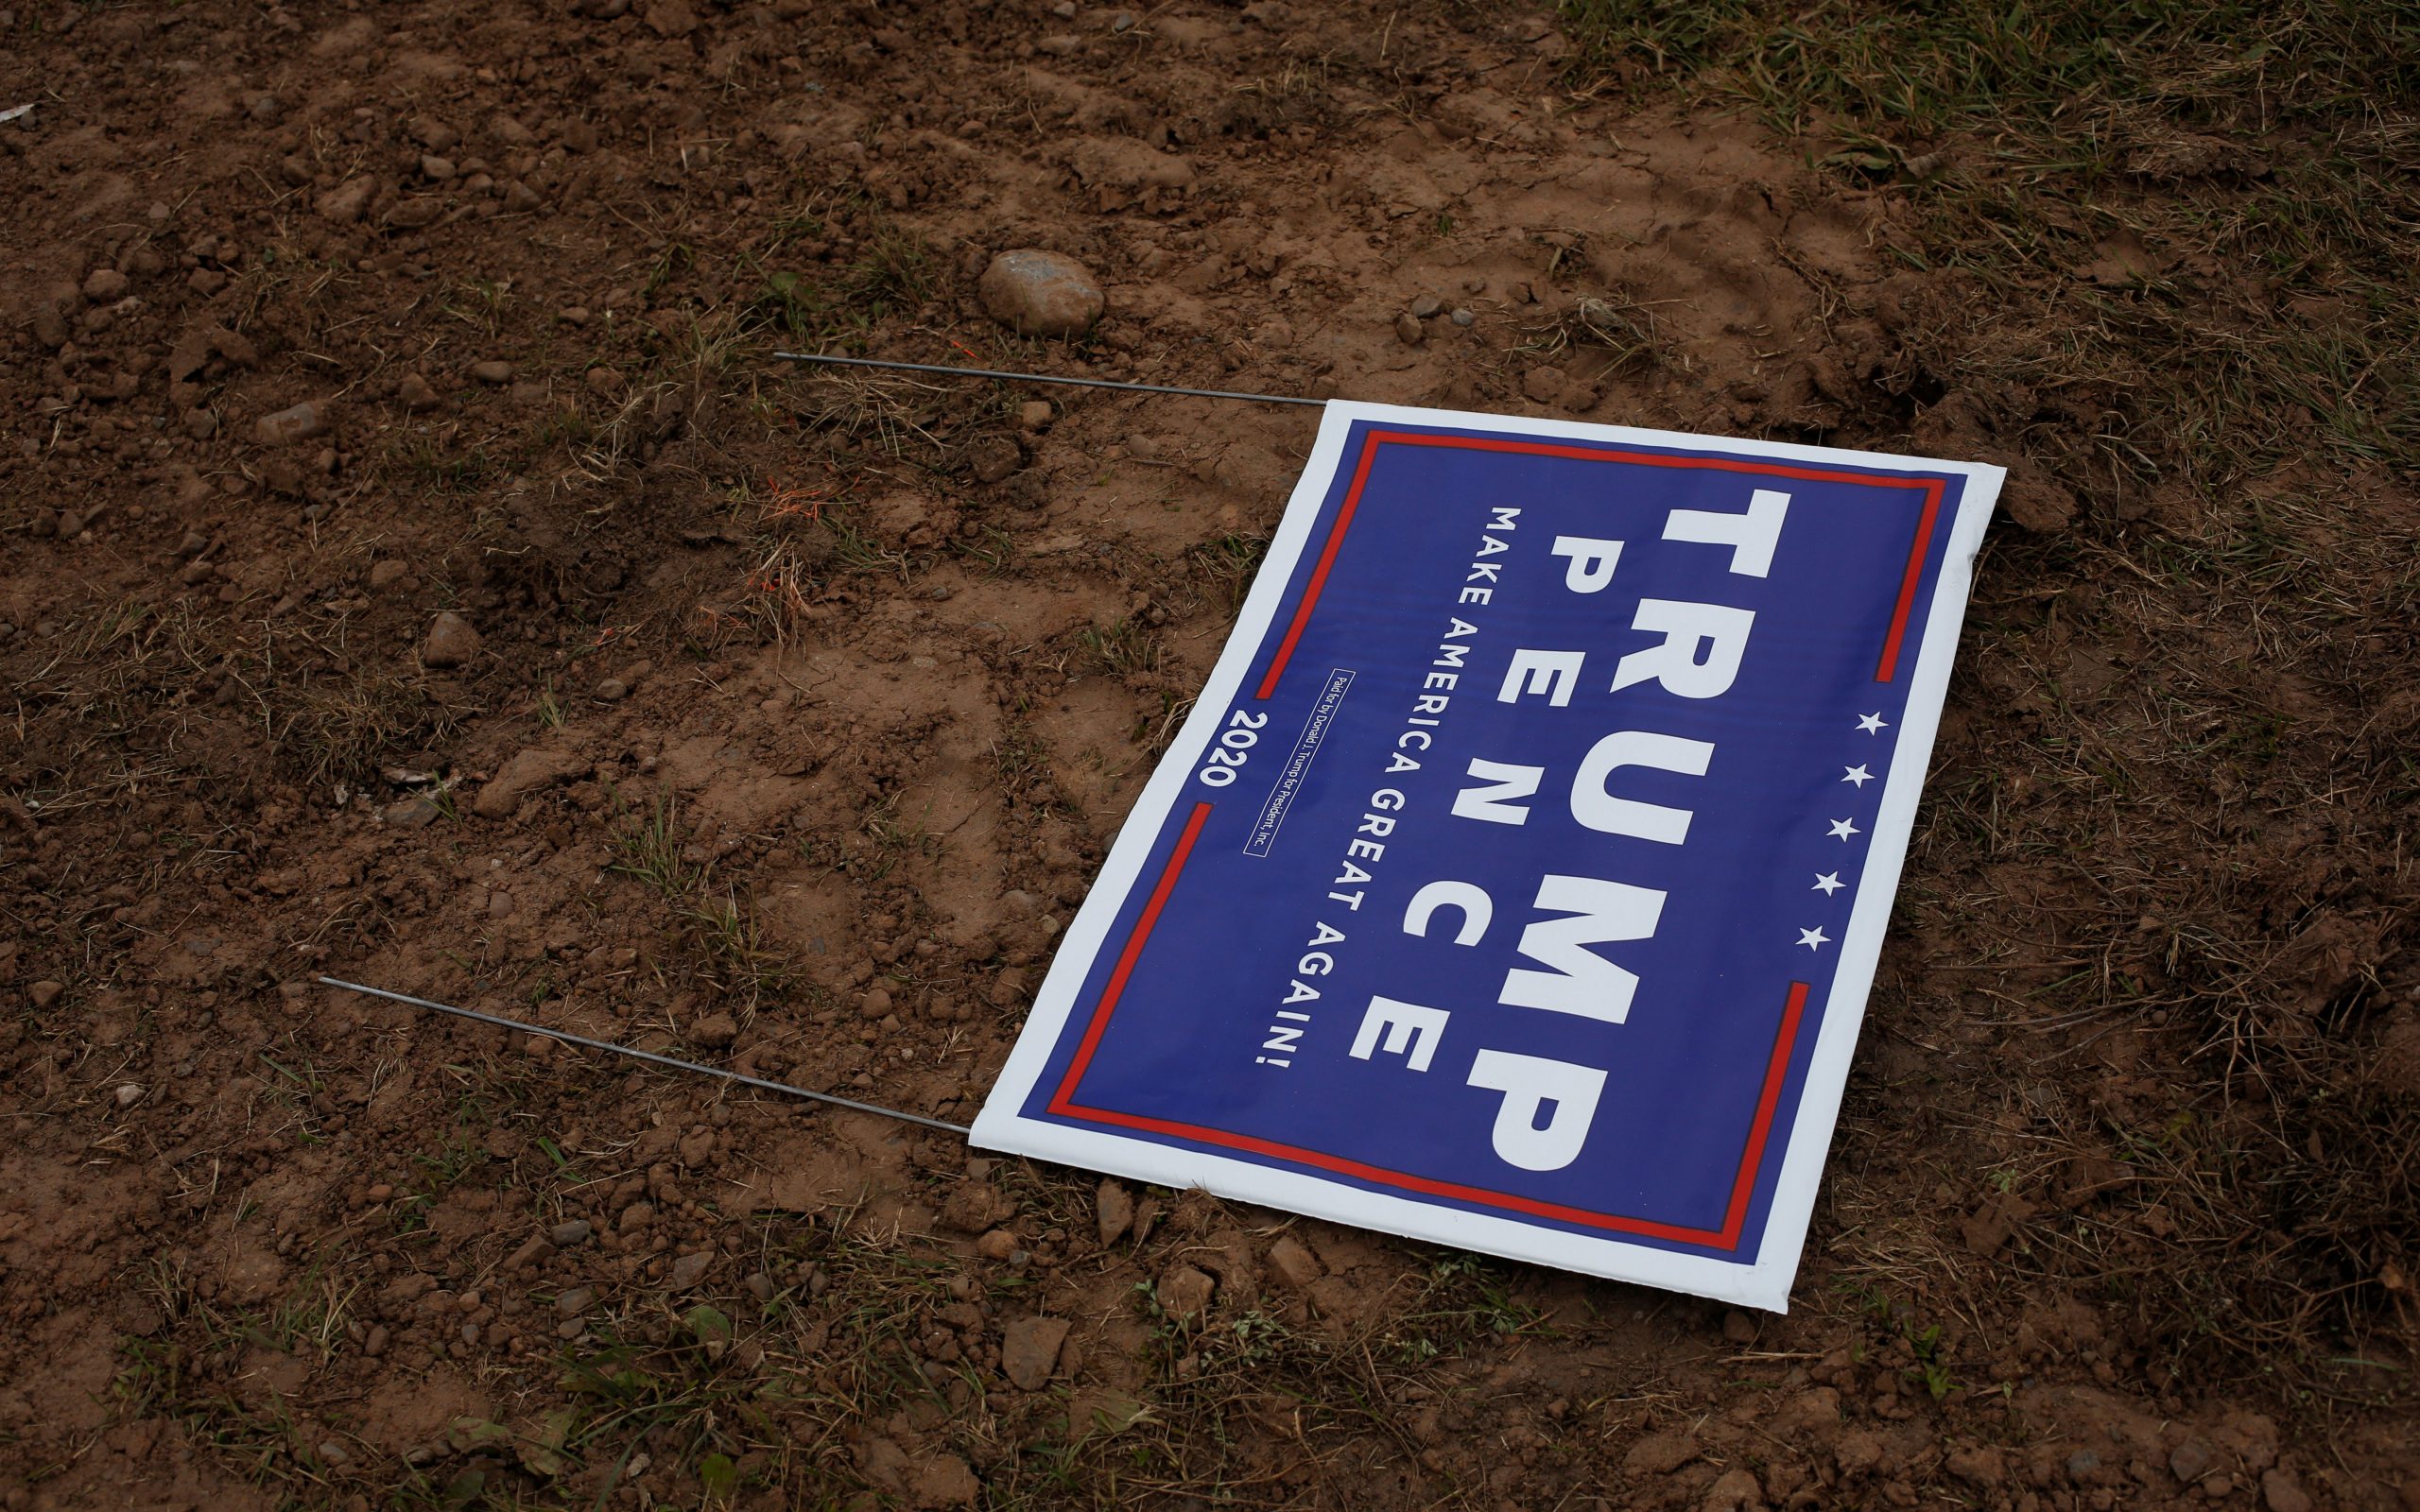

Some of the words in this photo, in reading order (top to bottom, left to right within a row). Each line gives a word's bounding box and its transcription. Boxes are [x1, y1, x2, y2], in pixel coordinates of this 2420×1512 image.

[1458, 507, 1522, 606] MAKE
[1324, 693, 1340, 704] for
[1330, 677, 1348, 693] Paid
[1384, 616, 1478, 773] AMERICA
[1305, 715, 1328, 744] Donald
[1317, 704, 1334, 714] by
[1199, 710, 1269, 787] 2020
[1288, 751, 1310, 778] Trump
[1283, 779, 1298, 790] for
[1348, 535, 1625, 1073] PENCE
[1259, 790, 1291, 831] President,
[1465, 489, 1792, 1172] TRUMP
[1253, 833, 1270, 847] Inc.
[1327, 788, 1406, 912] GREAT
[1254, 920, 1346, 1069] AGAIN!
